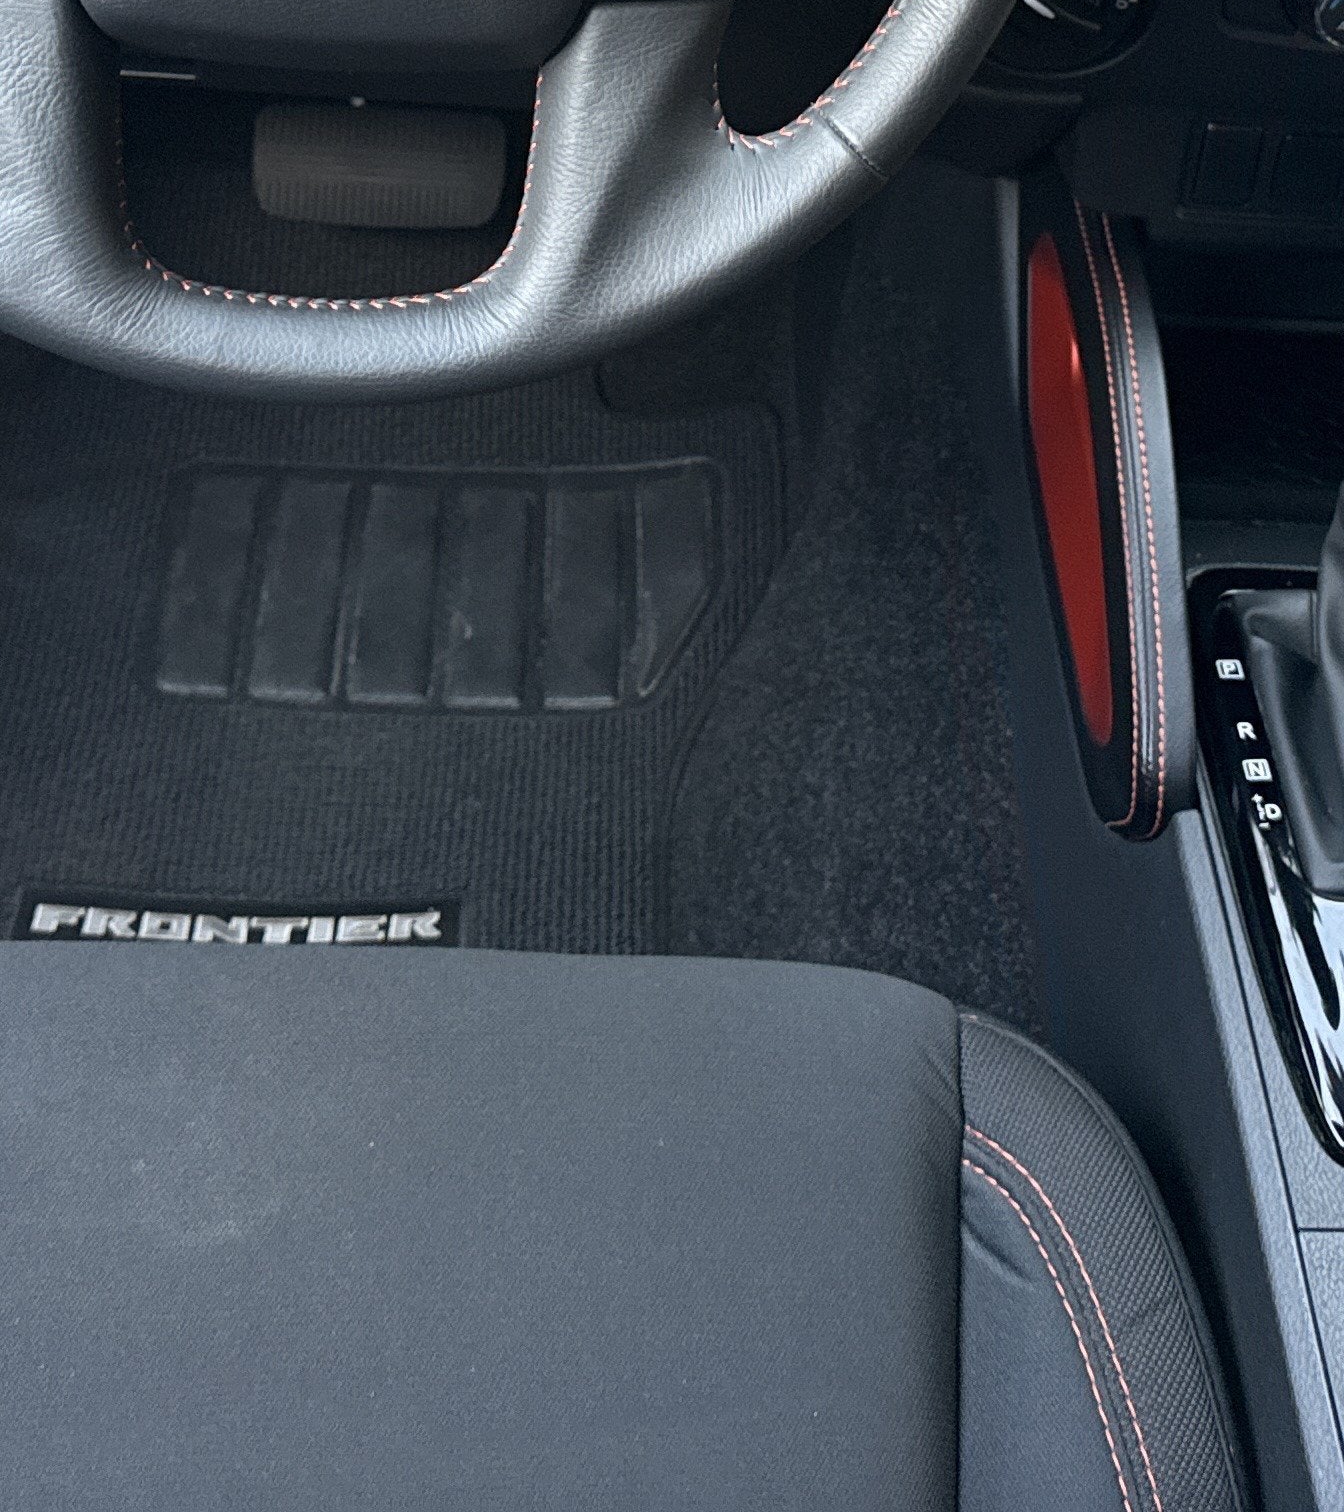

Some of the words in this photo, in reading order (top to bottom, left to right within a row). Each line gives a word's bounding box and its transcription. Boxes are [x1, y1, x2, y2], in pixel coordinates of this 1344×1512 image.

[1236, 721, 1257, 740] R
[1264, 803, 1283, 821] D
[29, 902, 443, 944] FRONTIER
